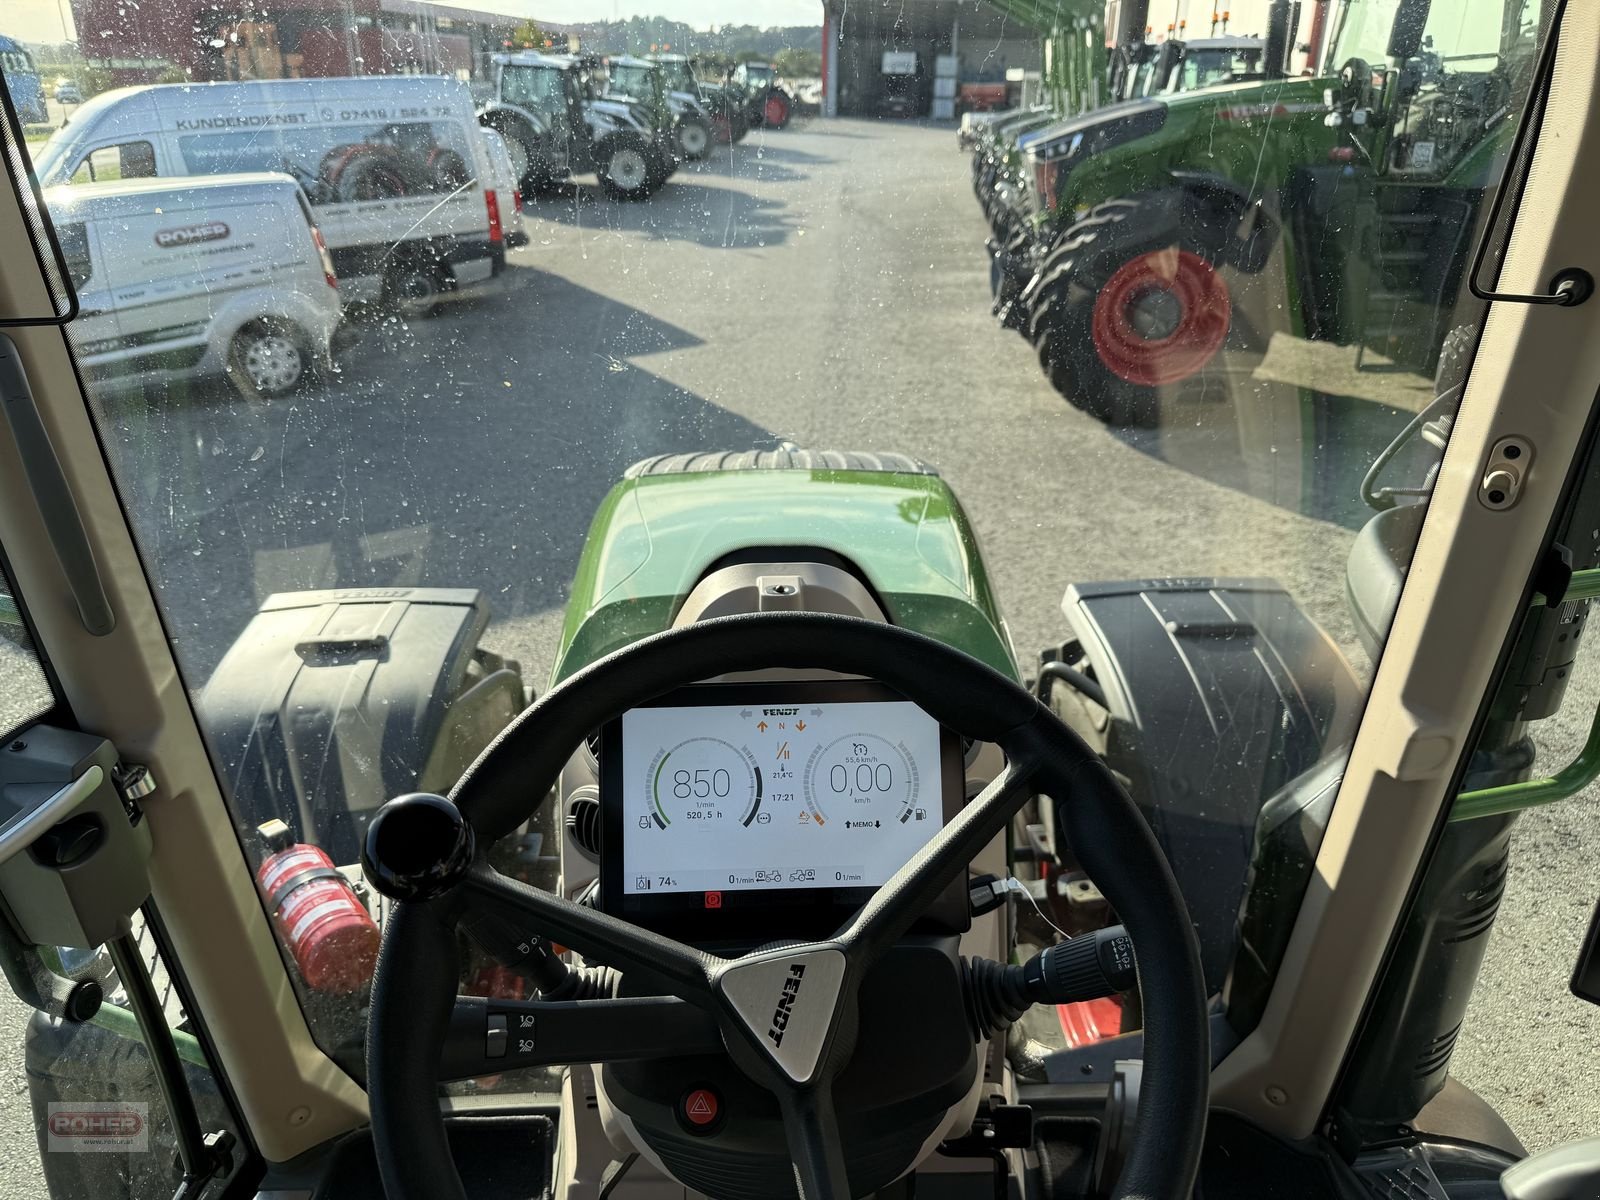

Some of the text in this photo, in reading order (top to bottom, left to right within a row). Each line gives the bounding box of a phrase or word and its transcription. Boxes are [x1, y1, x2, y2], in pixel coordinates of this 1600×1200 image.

[176, 113, 307, 131] KUNDENDIENST
[763, 708, 799, 716] FENDT
[779, 722, 785, 730] N
[673, 768, 730, 799] 850
[830, 763, 892, 797] 0,00
[772, 793, 794, 802] 17:21
[686, 810, 722, 820] 520,5 h
[767, 963, 807, 1049] FENDT
